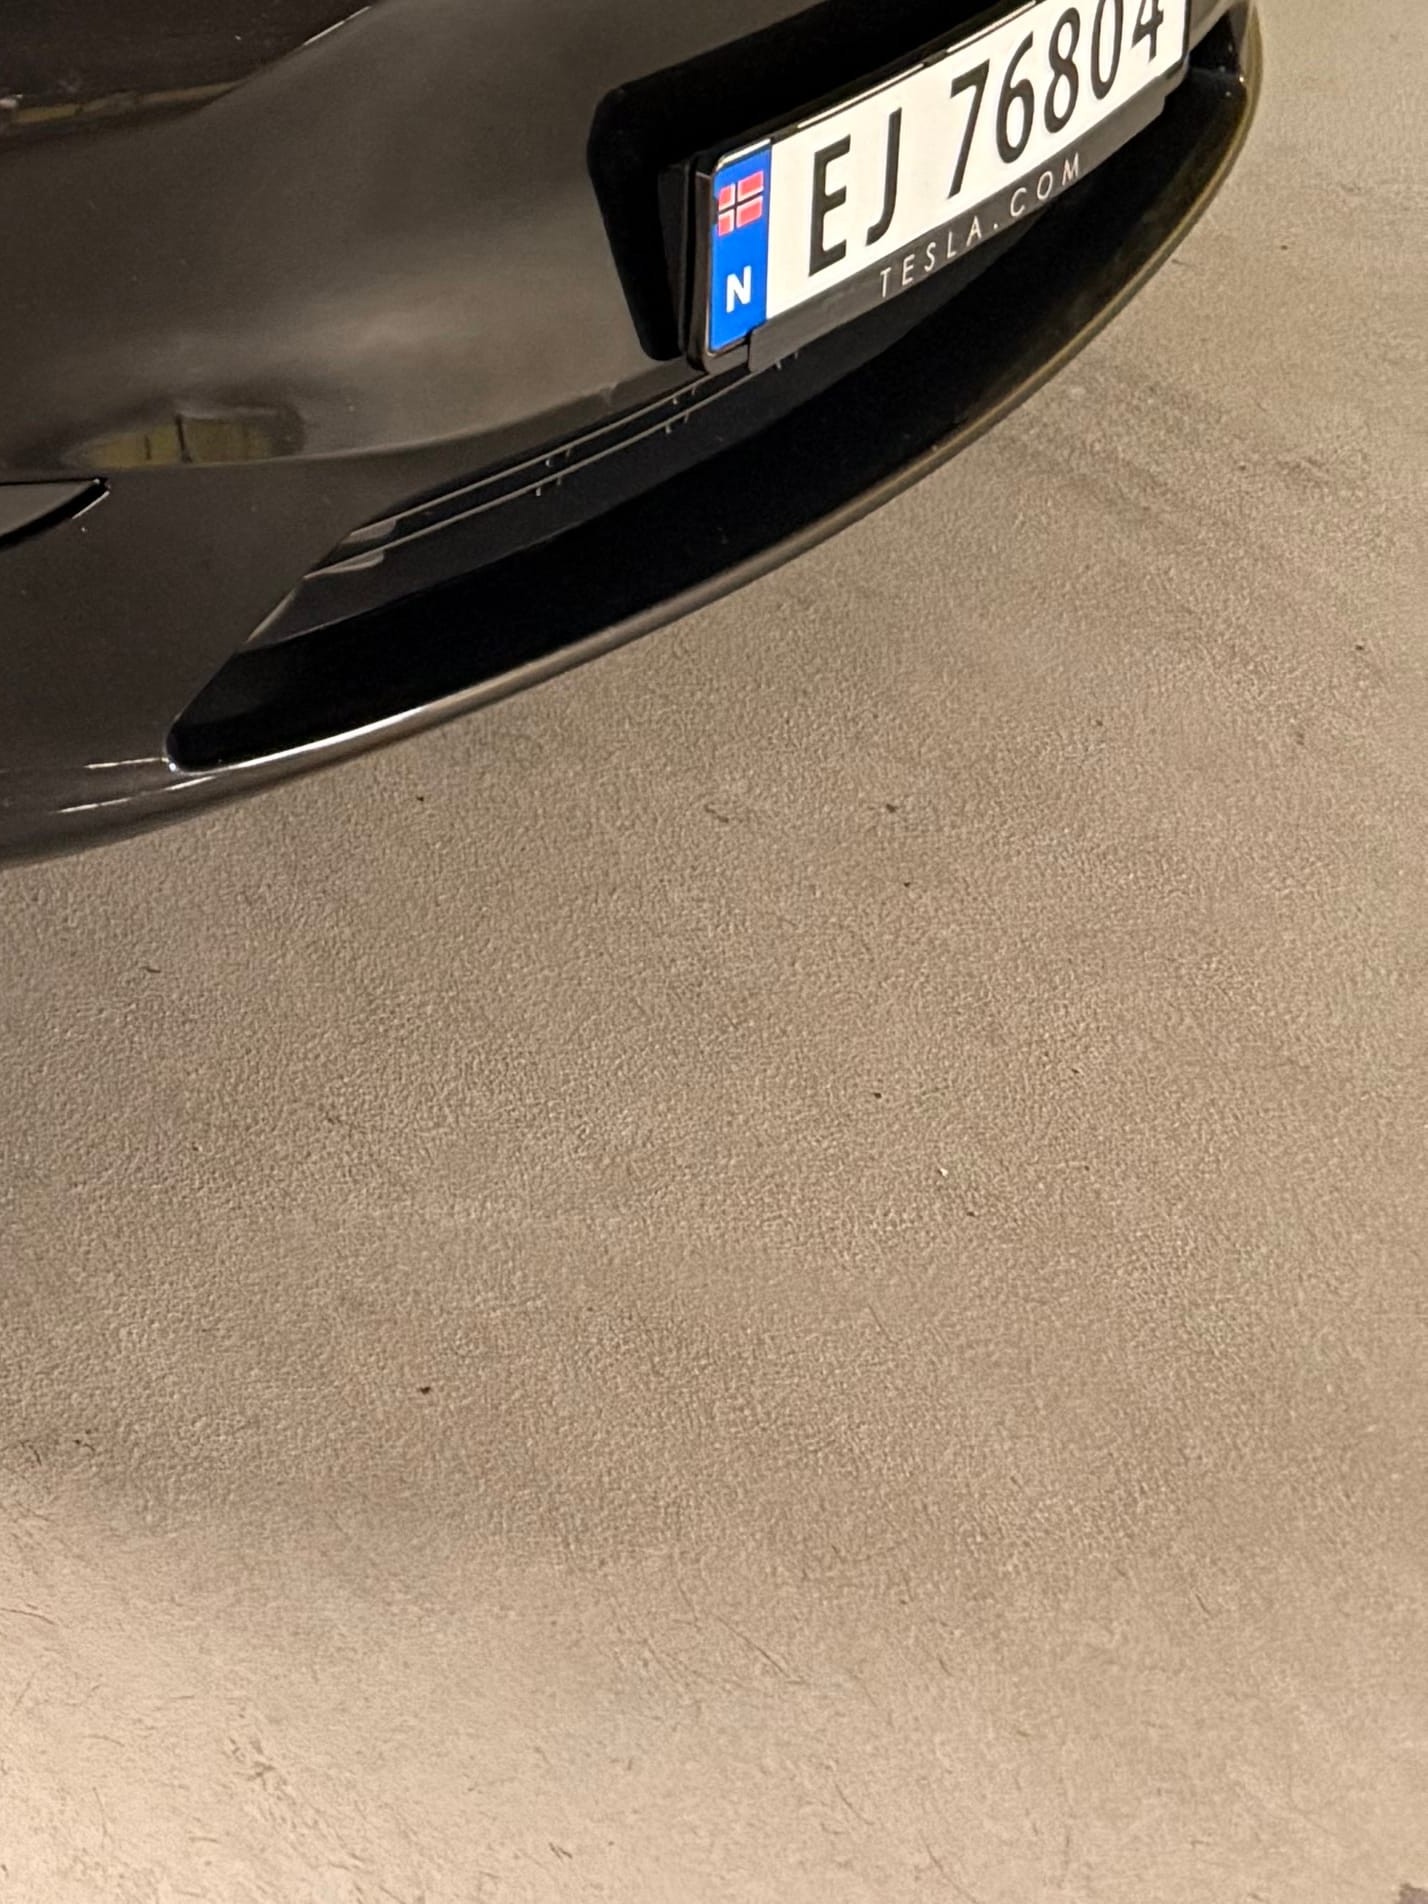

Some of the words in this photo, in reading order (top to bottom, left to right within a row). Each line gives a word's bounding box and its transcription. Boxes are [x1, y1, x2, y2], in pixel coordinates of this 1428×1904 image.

[808, 107, 902, 277] EJ
[880, 152, 1079, 298] TESLA.COM
[725, 265, 752, 313] N
